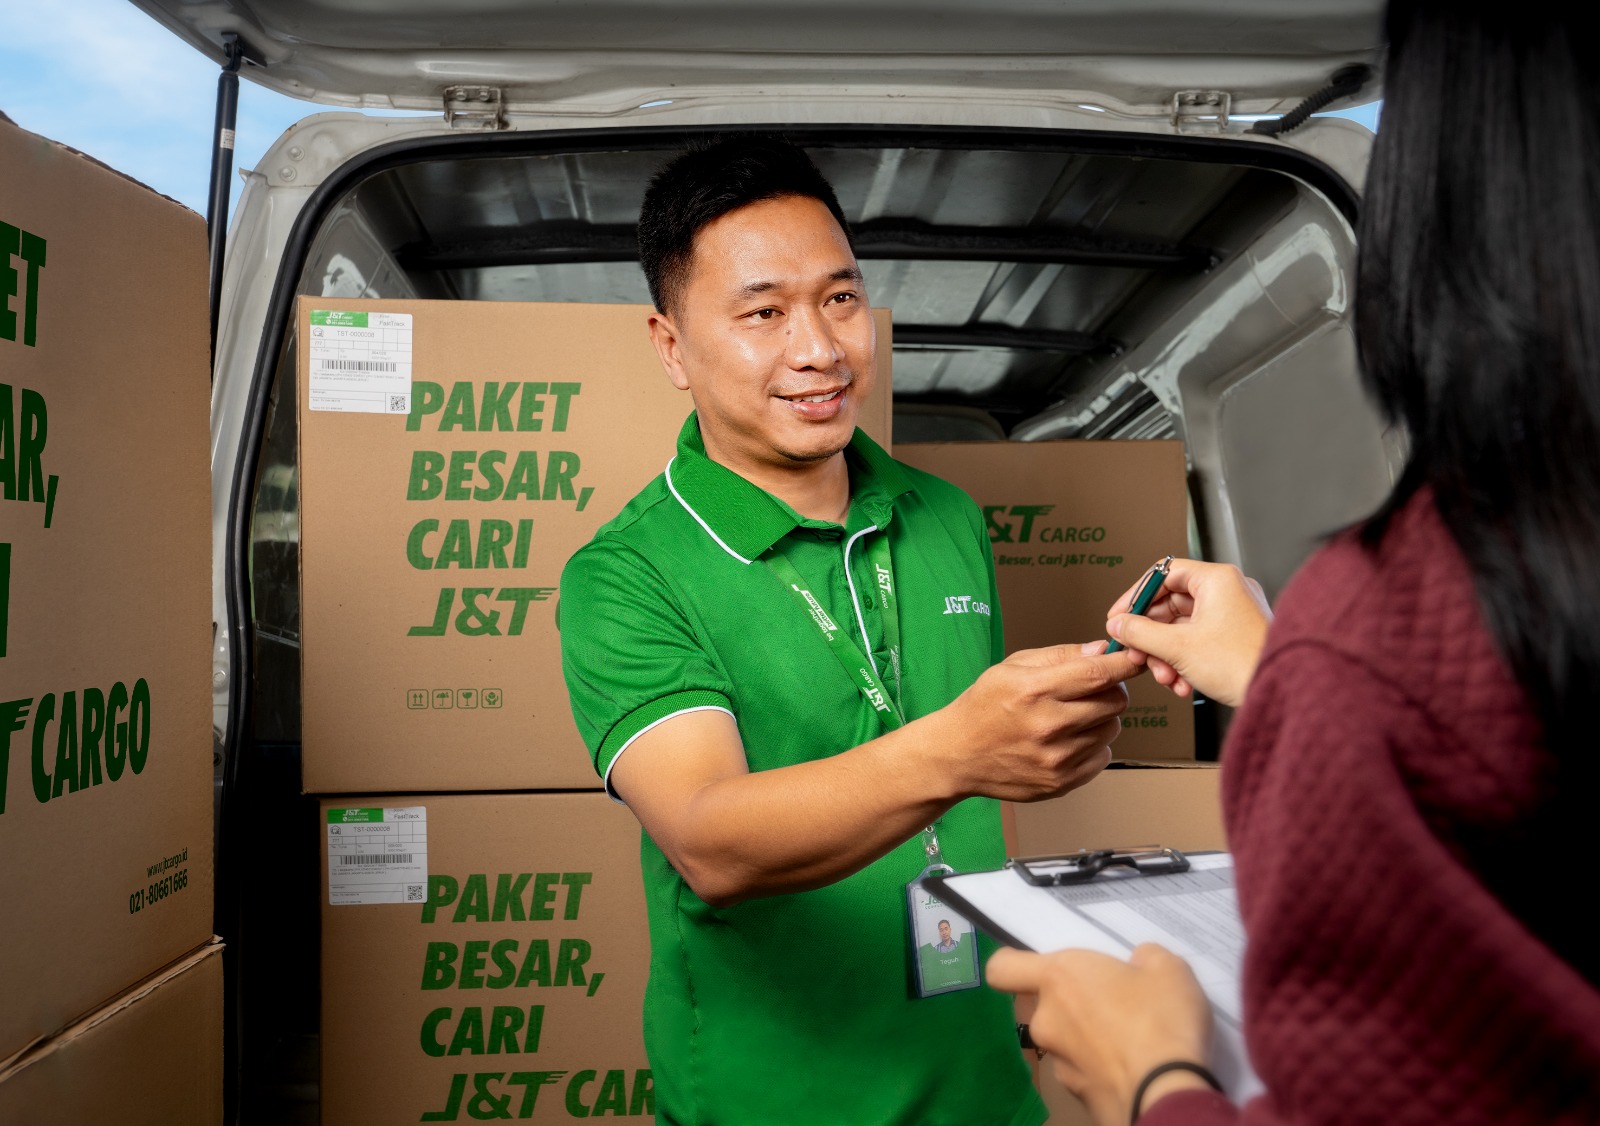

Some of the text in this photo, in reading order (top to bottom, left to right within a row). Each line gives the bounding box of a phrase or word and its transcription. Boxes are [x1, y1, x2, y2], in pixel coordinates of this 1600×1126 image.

[405, 381, 582, 432] PAKET
[406, 450, 595, 512] BESAR,
[406, 518, 534, 570] CARI
[1040, 527, 1106, 543] CARGO
[875, 563, 892, 596] J&T
[998, 554, 1035, 567] Besar,
[1038, 553, 1062, 566] Cari
[1063, 553, 1085, 568] J&T
[1088, 554, 1124, 568] Cargo
[406, 587, 558, 637] J&T
[943, 595, 971, 615] J&T
[860, 668, 892, 712] J&T CARGO
[31, 677, 151, 804] CARGO
[129, 868, 188, 915] 021-80661666
[420, 872, 592, 924] PAKET
[420, 938, 606, 997] BESAR,
[940, 957, 960, 966] Teguh
[419, 1005, 546, 1058] CARI
[420, 1070, 569, 1122] J&T
